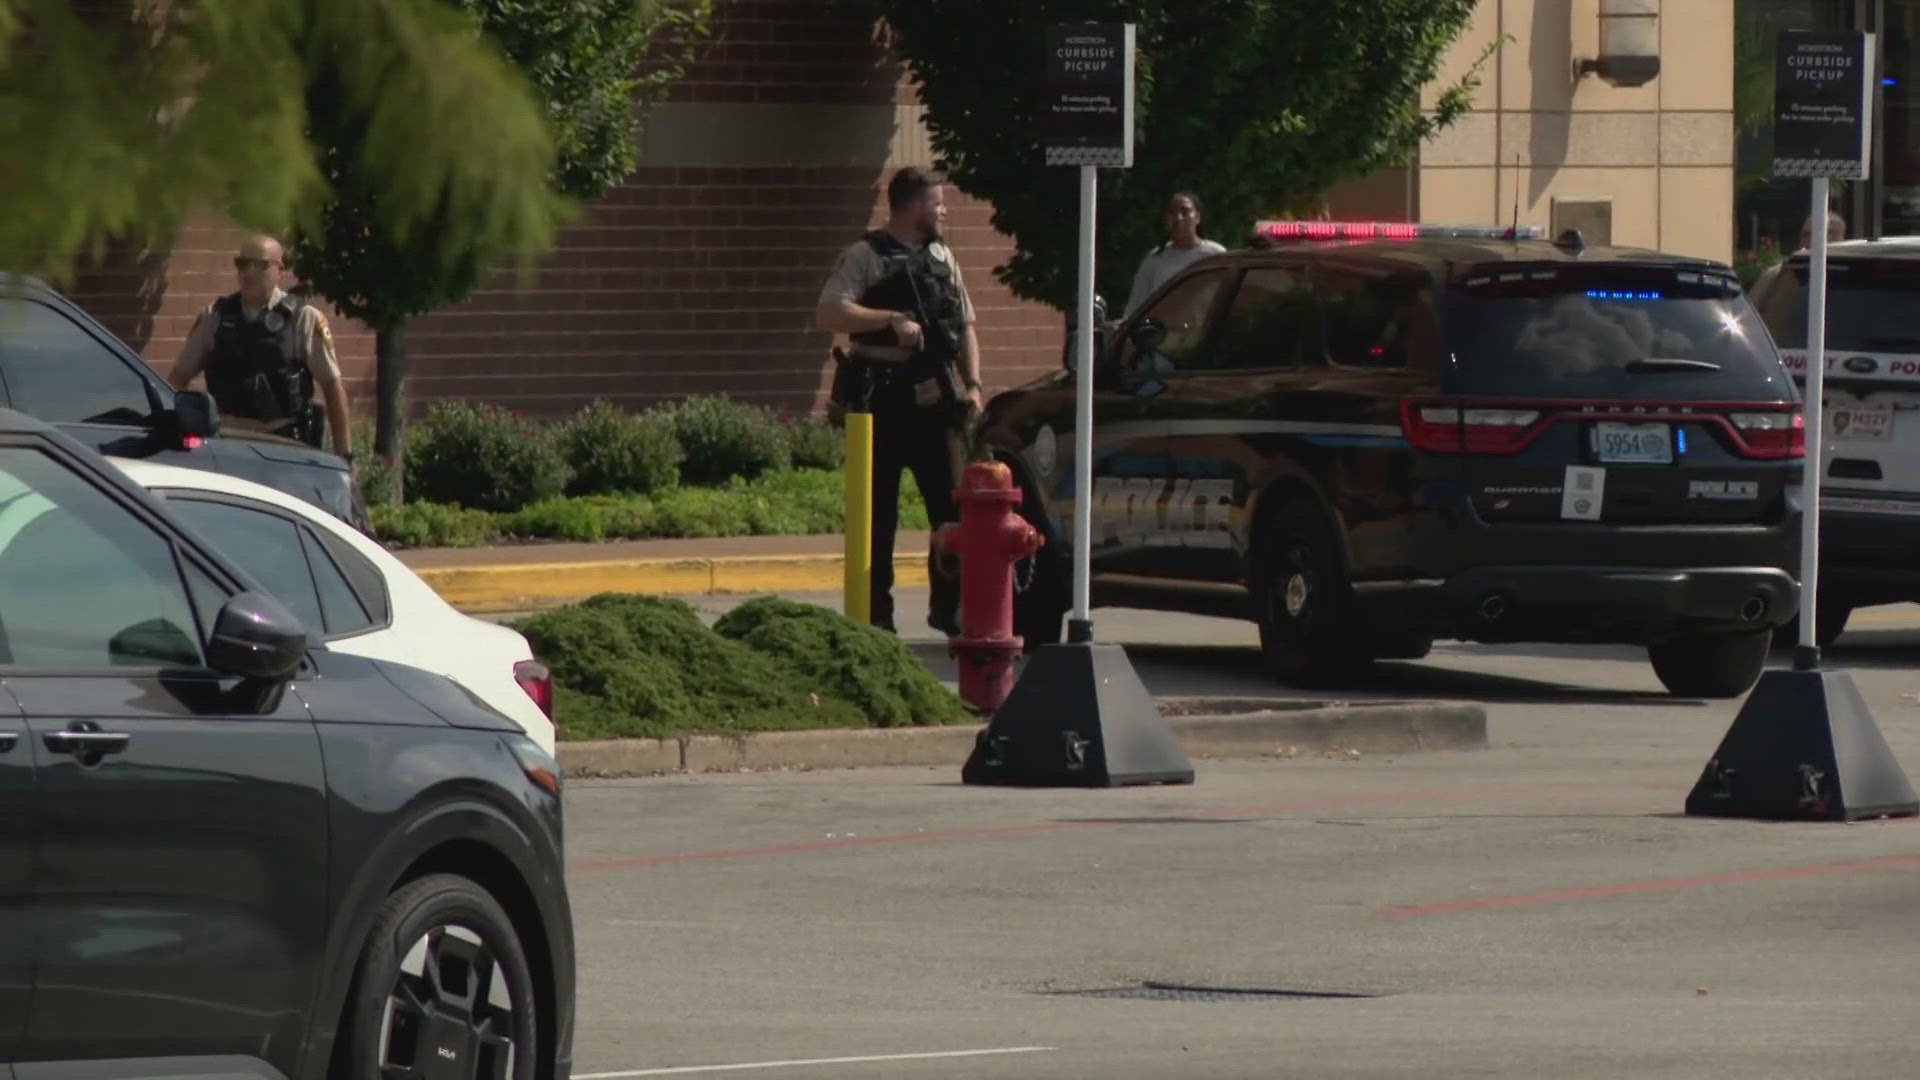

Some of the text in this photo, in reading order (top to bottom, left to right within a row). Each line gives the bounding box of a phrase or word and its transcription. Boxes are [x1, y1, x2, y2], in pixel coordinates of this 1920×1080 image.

[1057, 48, 1115, 58] CURBSIDE
[1065, 61, 1107, 71] PICKUP
[1787, 56, 1853, 66] CURBSIDE
[1796, 69, 1844, 80] PICKUP
[1605, 432, 1640, 456] 5954
